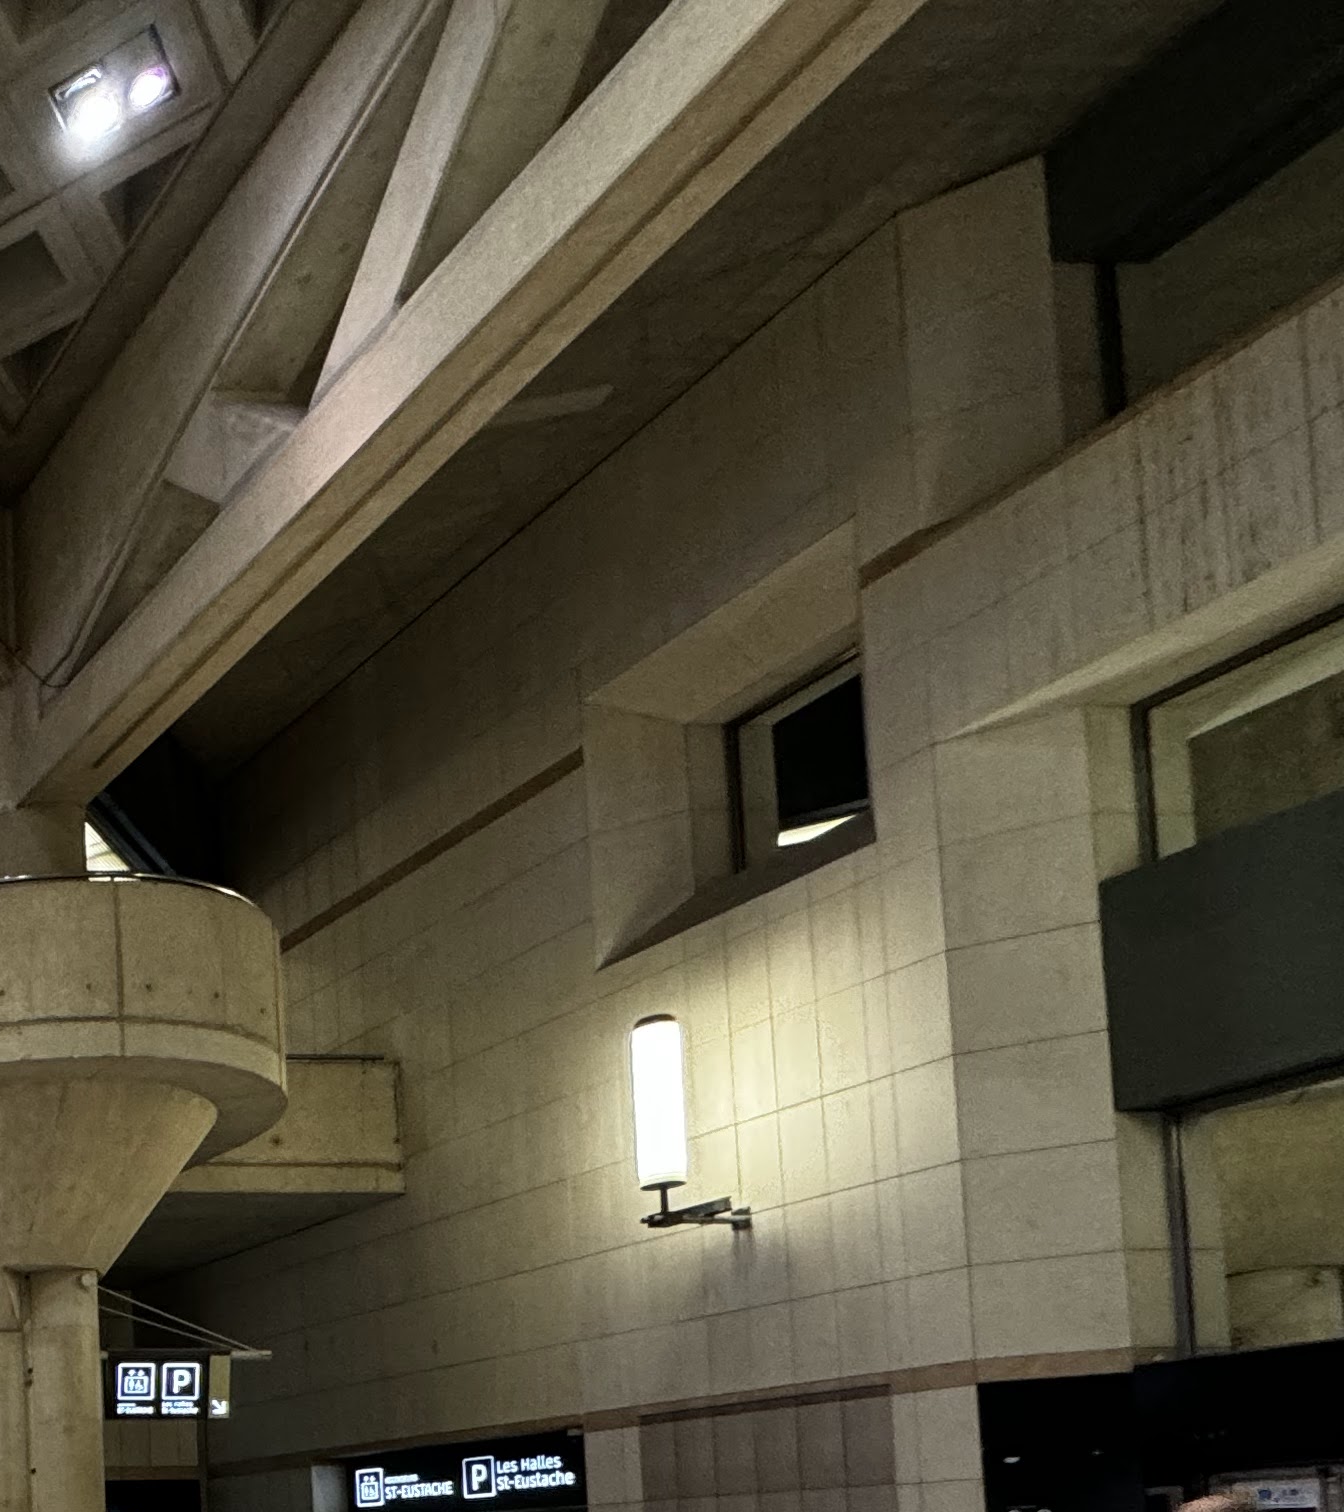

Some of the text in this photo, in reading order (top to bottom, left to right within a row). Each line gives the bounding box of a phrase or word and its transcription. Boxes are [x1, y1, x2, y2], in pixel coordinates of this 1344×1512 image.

[496, 1455, 562, 1475] Les Halles
[384, 1480, 454, 1500] ST-EUSTACHE
[496, 1470, 576, 1492] St-Eustache
